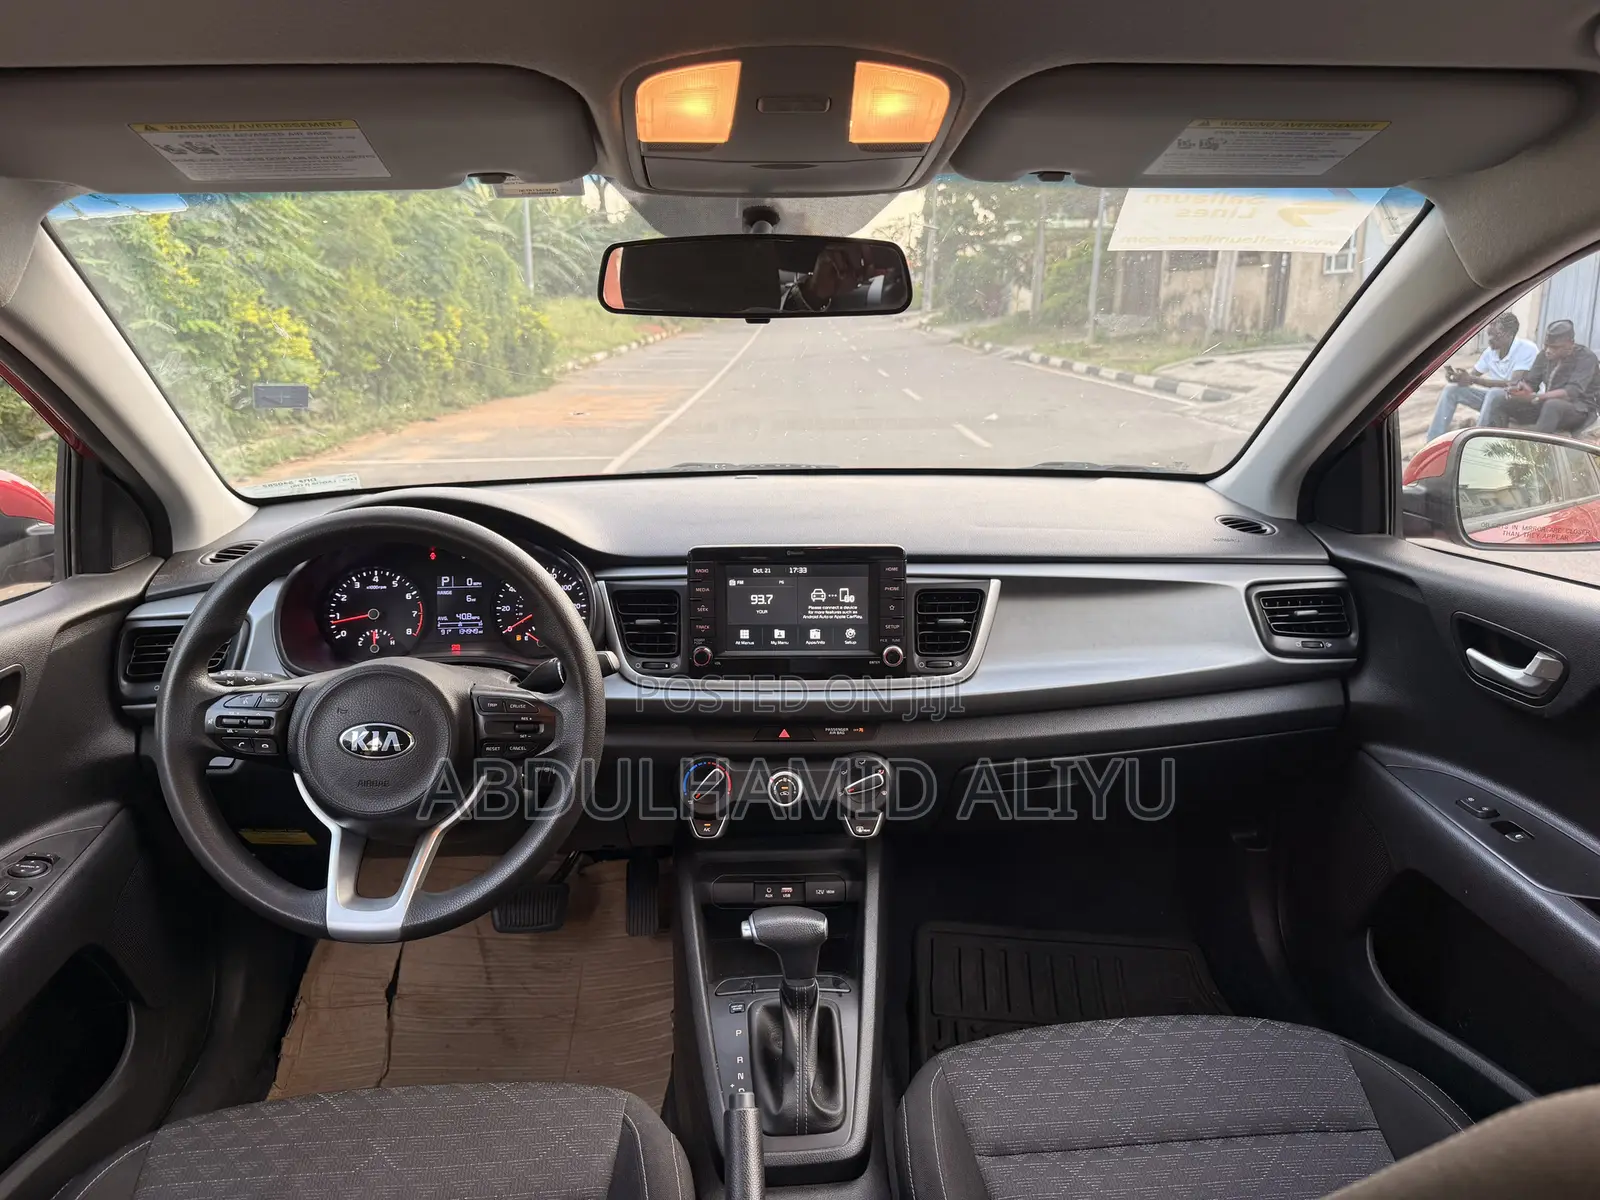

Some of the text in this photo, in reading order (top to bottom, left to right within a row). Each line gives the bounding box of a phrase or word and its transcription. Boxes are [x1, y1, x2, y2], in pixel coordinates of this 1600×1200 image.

[441, 576, 450, 586] P
[750, 594, 774, 605] 93.7
[350, 730, 401, 751] KIA
